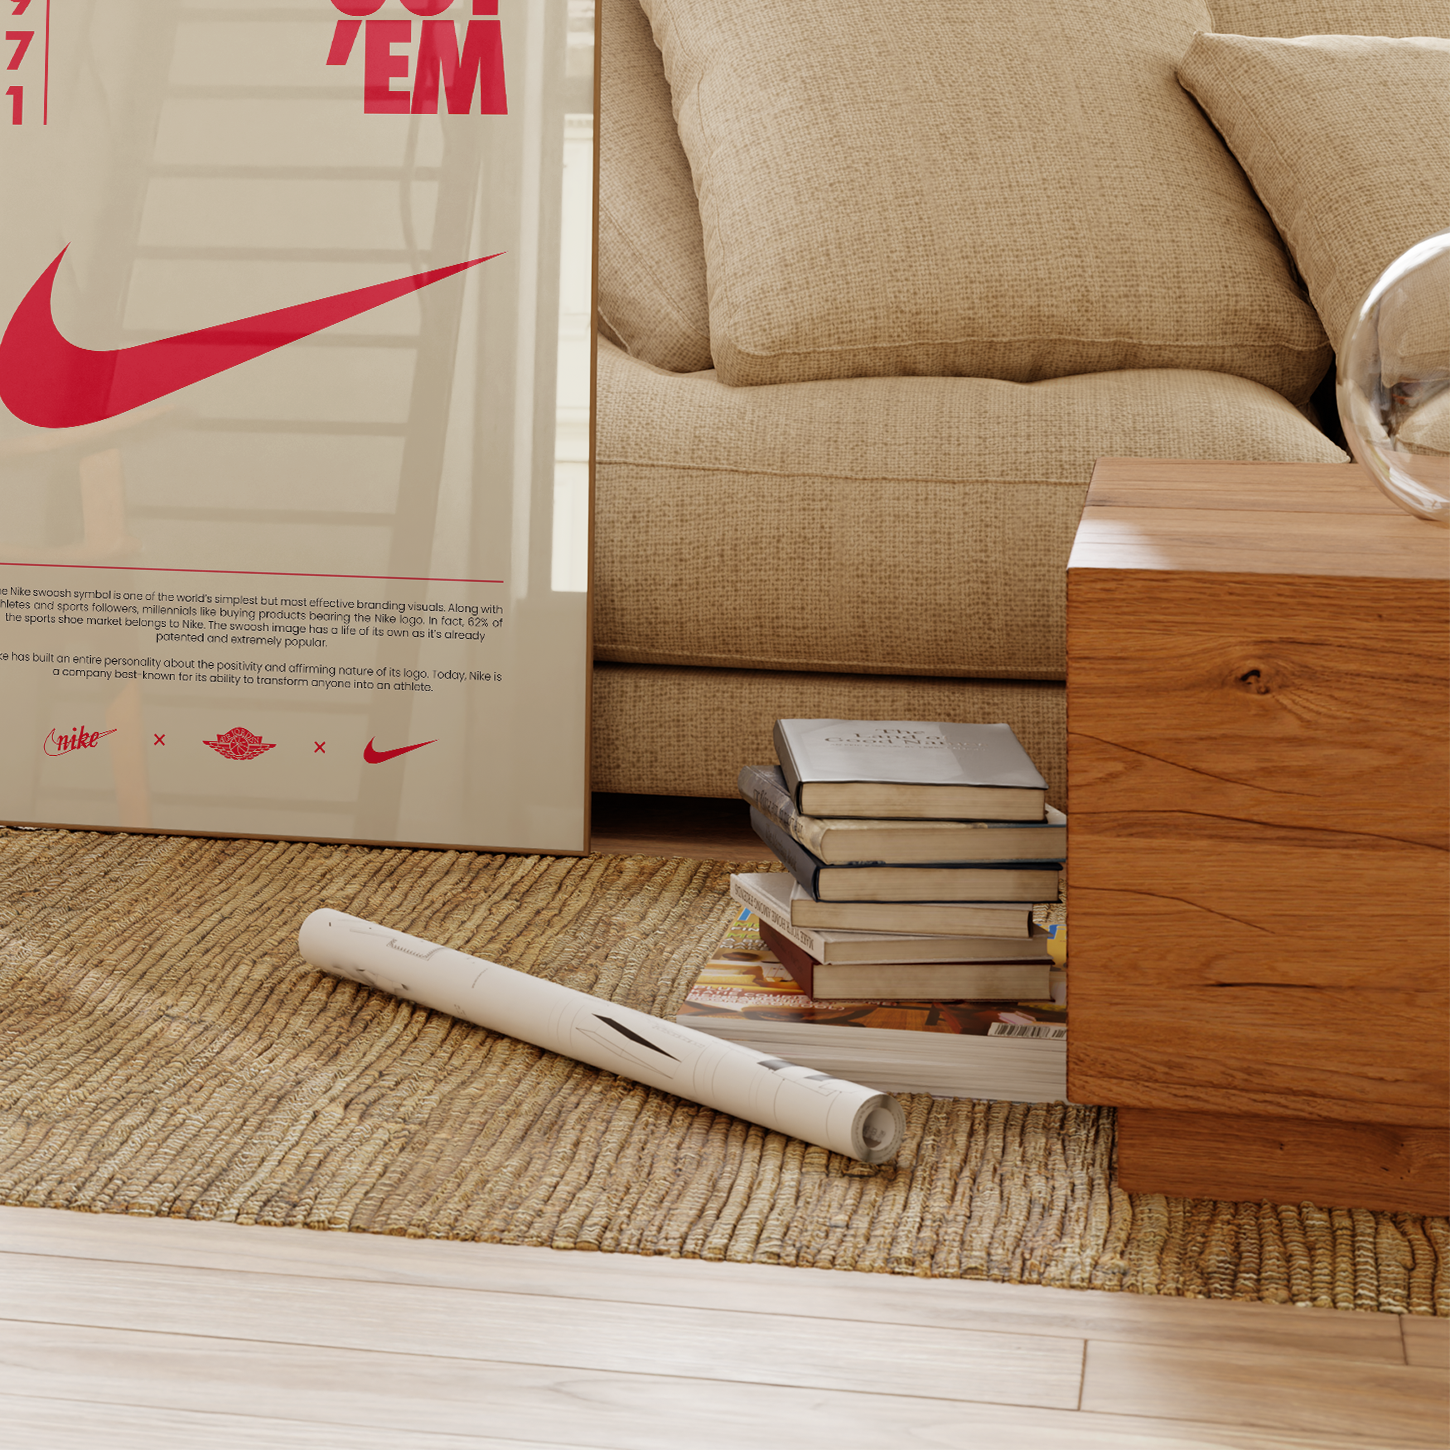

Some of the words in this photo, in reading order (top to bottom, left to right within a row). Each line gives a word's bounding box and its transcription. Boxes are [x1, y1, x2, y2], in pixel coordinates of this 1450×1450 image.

[326, 20, 508, 115] 'EM
[11, 586, 31, 596] Nike
[33, 588, 71, 598] swoosh
[74, 590, 111, 600] symbol
[113, 590, 121, 600] is
[145, 591, 155, 601] of
[158, 592, 174, 602] the
[176, 594, 212, 603] world's
[215, 595, 258, 606] simplest
[261, 596, 278, 606] but
[281, 598, 307, 607] most
[309, 597, 354, 609] effective
[357, 600, 405, 613] branding
[408, 601, 445, 613] visuals.
[448, 603, 478, 616] Along
[480, 604, 503, 614] with
[34, 601, 54, 610] and
[57, 603, 88, 613] sports
[92, 603, 139, 614] followers,
[143, 605, 197, 617] millennials
[200, 607, 216, 616] like
[220, 607, 255, 621] buying
[259, 610, 306, 621] products
[309, 611, 350, 625] bearing
[354, 613, 371, 623] the
[375, 613, 396, 624] Nike
[400, 615, 425, 627] logo.
[429, 616, 437, 625] In
[441, 616, 464, 627] fact,
[468, 617, 488, 627] 62%
[492, 618, 503, 628] of
[6, 613, 22, 622] the
[24, 614, 55, 625] sports
[58, 614, 83, 624] shoe
[87, 616, 122, 626] market
[125, 617, 166, 630] belongs
[169, 619, 180, 628] to
[182, 619, 206, 629] Nike.
[208, 620, 227, 630] The
[230, 622, 269, 632] swoosh
[272, 623, 306, 636] image
[309, 624, 328, 634] has
[341, 625, 356, 635] life
[359, 626, 369, 635] of
[372, 627, 384, 636] its
[387, 629, 409, 637] own
[412, 630, 425, 638] as
[428, 629, 442, 638] it's
[445, 630, 485, 643] already
[156, 633, 204, 643] patented
[207, 634, 228, 644] and
[231, 636, 282, 647] extremely
[285, 637, 327, 648] popular.
[12, 651, 30, 662] has
[33, 652, 54, 663] built
[56, 655, 70, 664] an
[73, 654, 102, 665] entire
[104, 657, 161, 670] personality
[164, 658, 195, 669] about
[198, 660, 214, 669] the
[217, 660, 263, 674] positivity
[265, 663, 286, 672] and
[288, 663, 335, 677] affirming
[339, 666, 374, 677] nature
[376, 666, 387, 676] of
[389, 667, 401, 678] its
[404, 668, 429, 681] logo.
[433, 670, 467, 682] Today,
[469, 671, 491, 681] Nike
[494, 672, 502, 682] is
[62, 668, 112, 680] company
[115, 669, 175, 681] best-known
[178, 672, 193, 681] for
[195, 673, 207, 682] its
[209, 673, 241, 685] ability
[243, 675, 254, 684] to
[257, 675, 308, 686] transform
[311, 679, 351, 689] anyone
[354, 679, 374, 690] into
[393, 680, 433, 692] athlete.
[56, 726, 99, 750] nike
